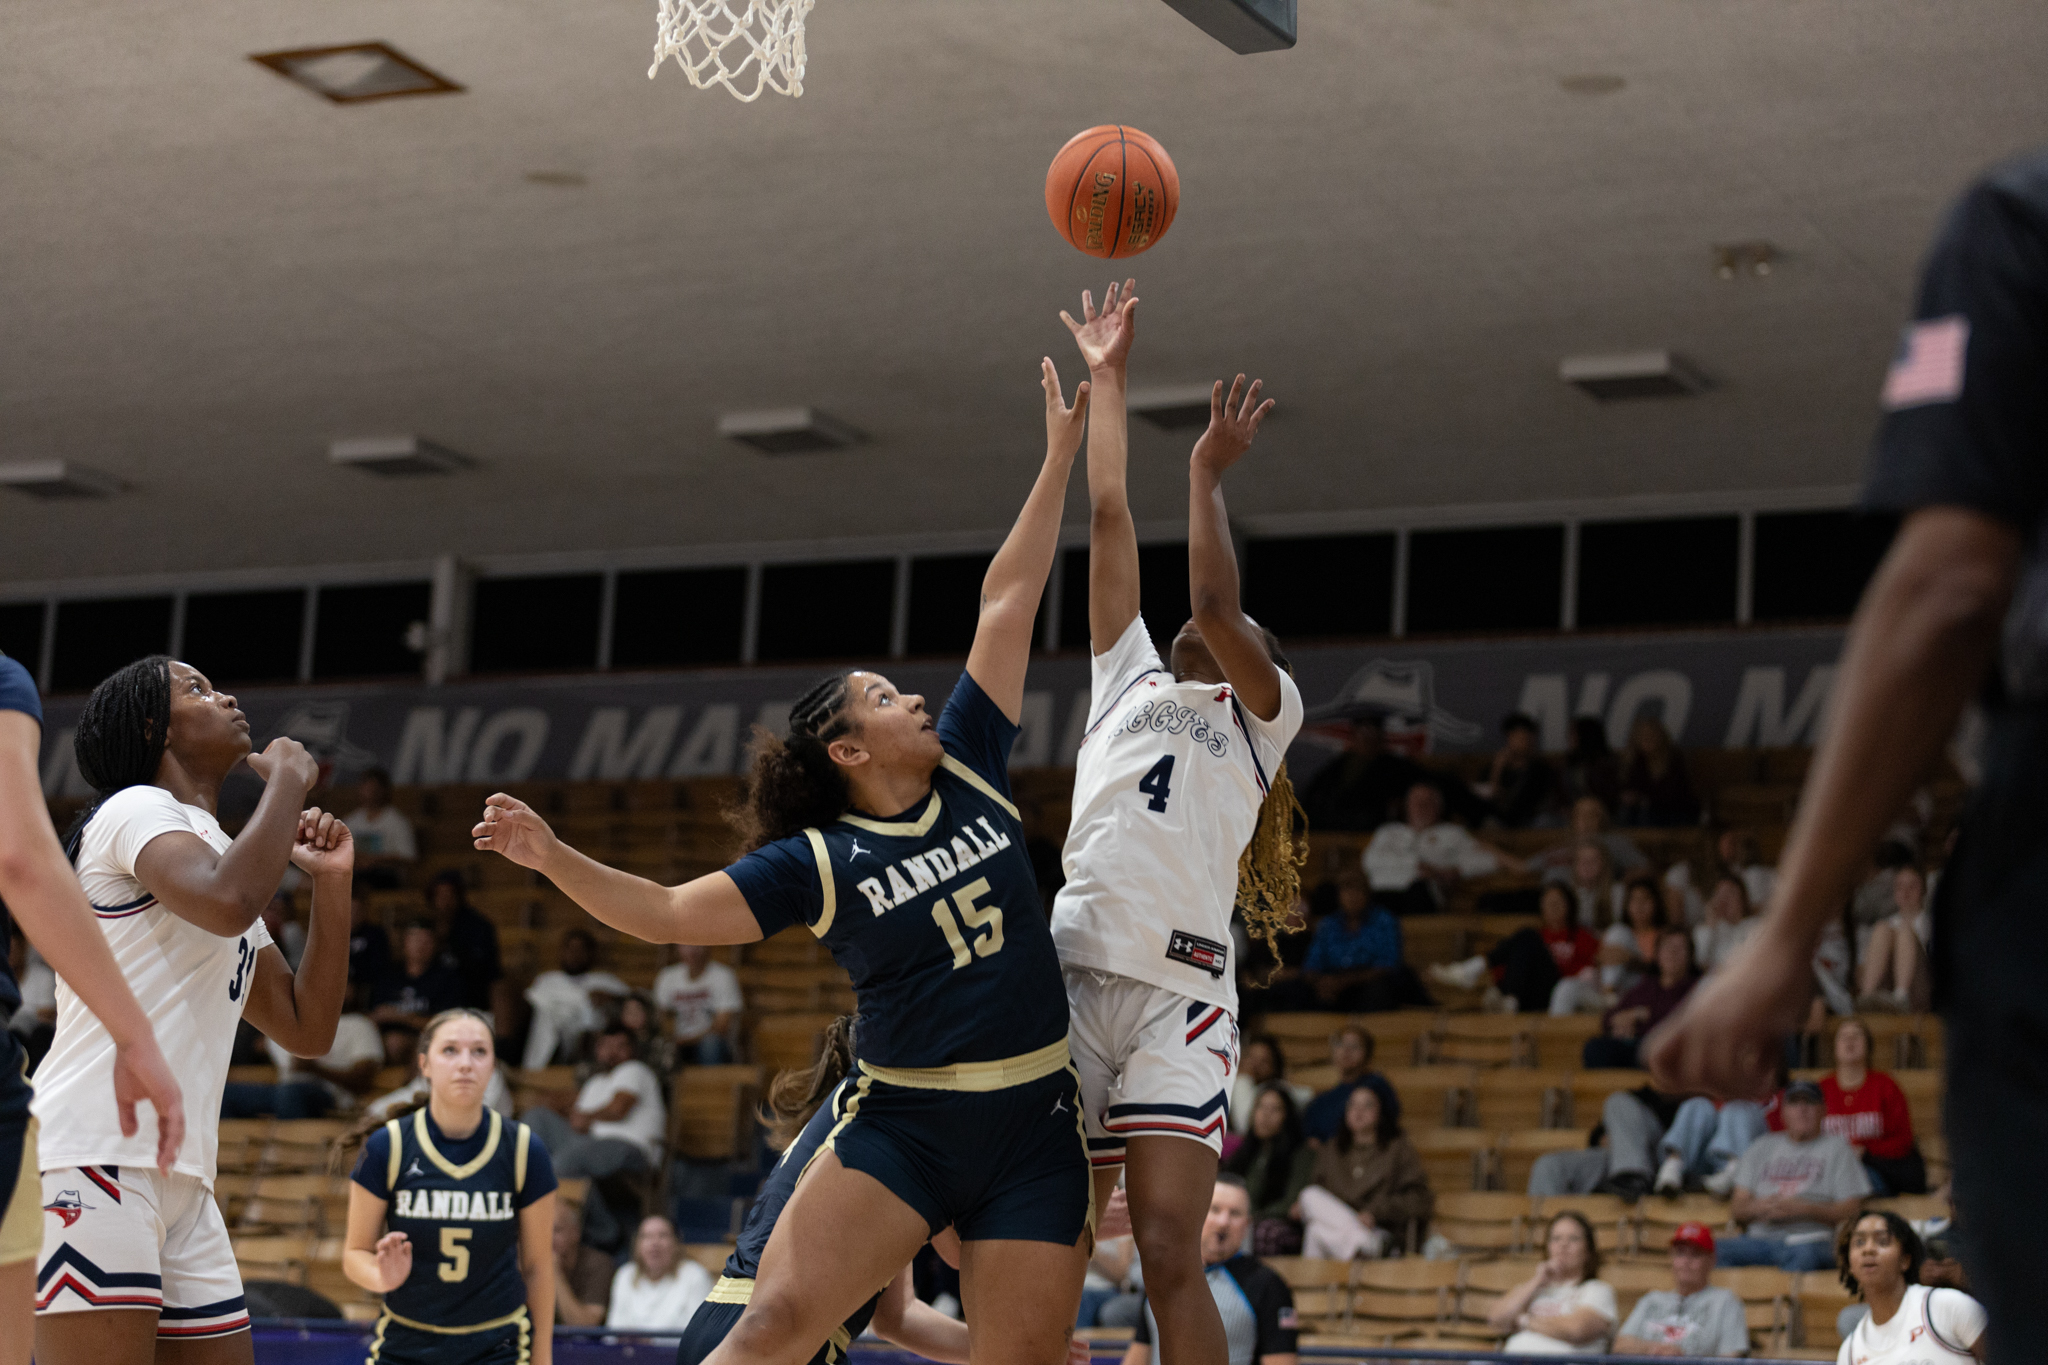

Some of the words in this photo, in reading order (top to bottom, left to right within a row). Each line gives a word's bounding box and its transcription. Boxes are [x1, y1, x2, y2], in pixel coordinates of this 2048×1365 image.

[391, 706, 550, 785] NO
[1107, 700, 1229, 757] GGIES
[1138, 754, 1175, 813] 4
[856, 815, 1012, 918] RANDALL
[931, 876, 1005, 971] 15
[394, 1188, 515, 1221] RANDALL
[437, 1226, 473, 1284] 5
